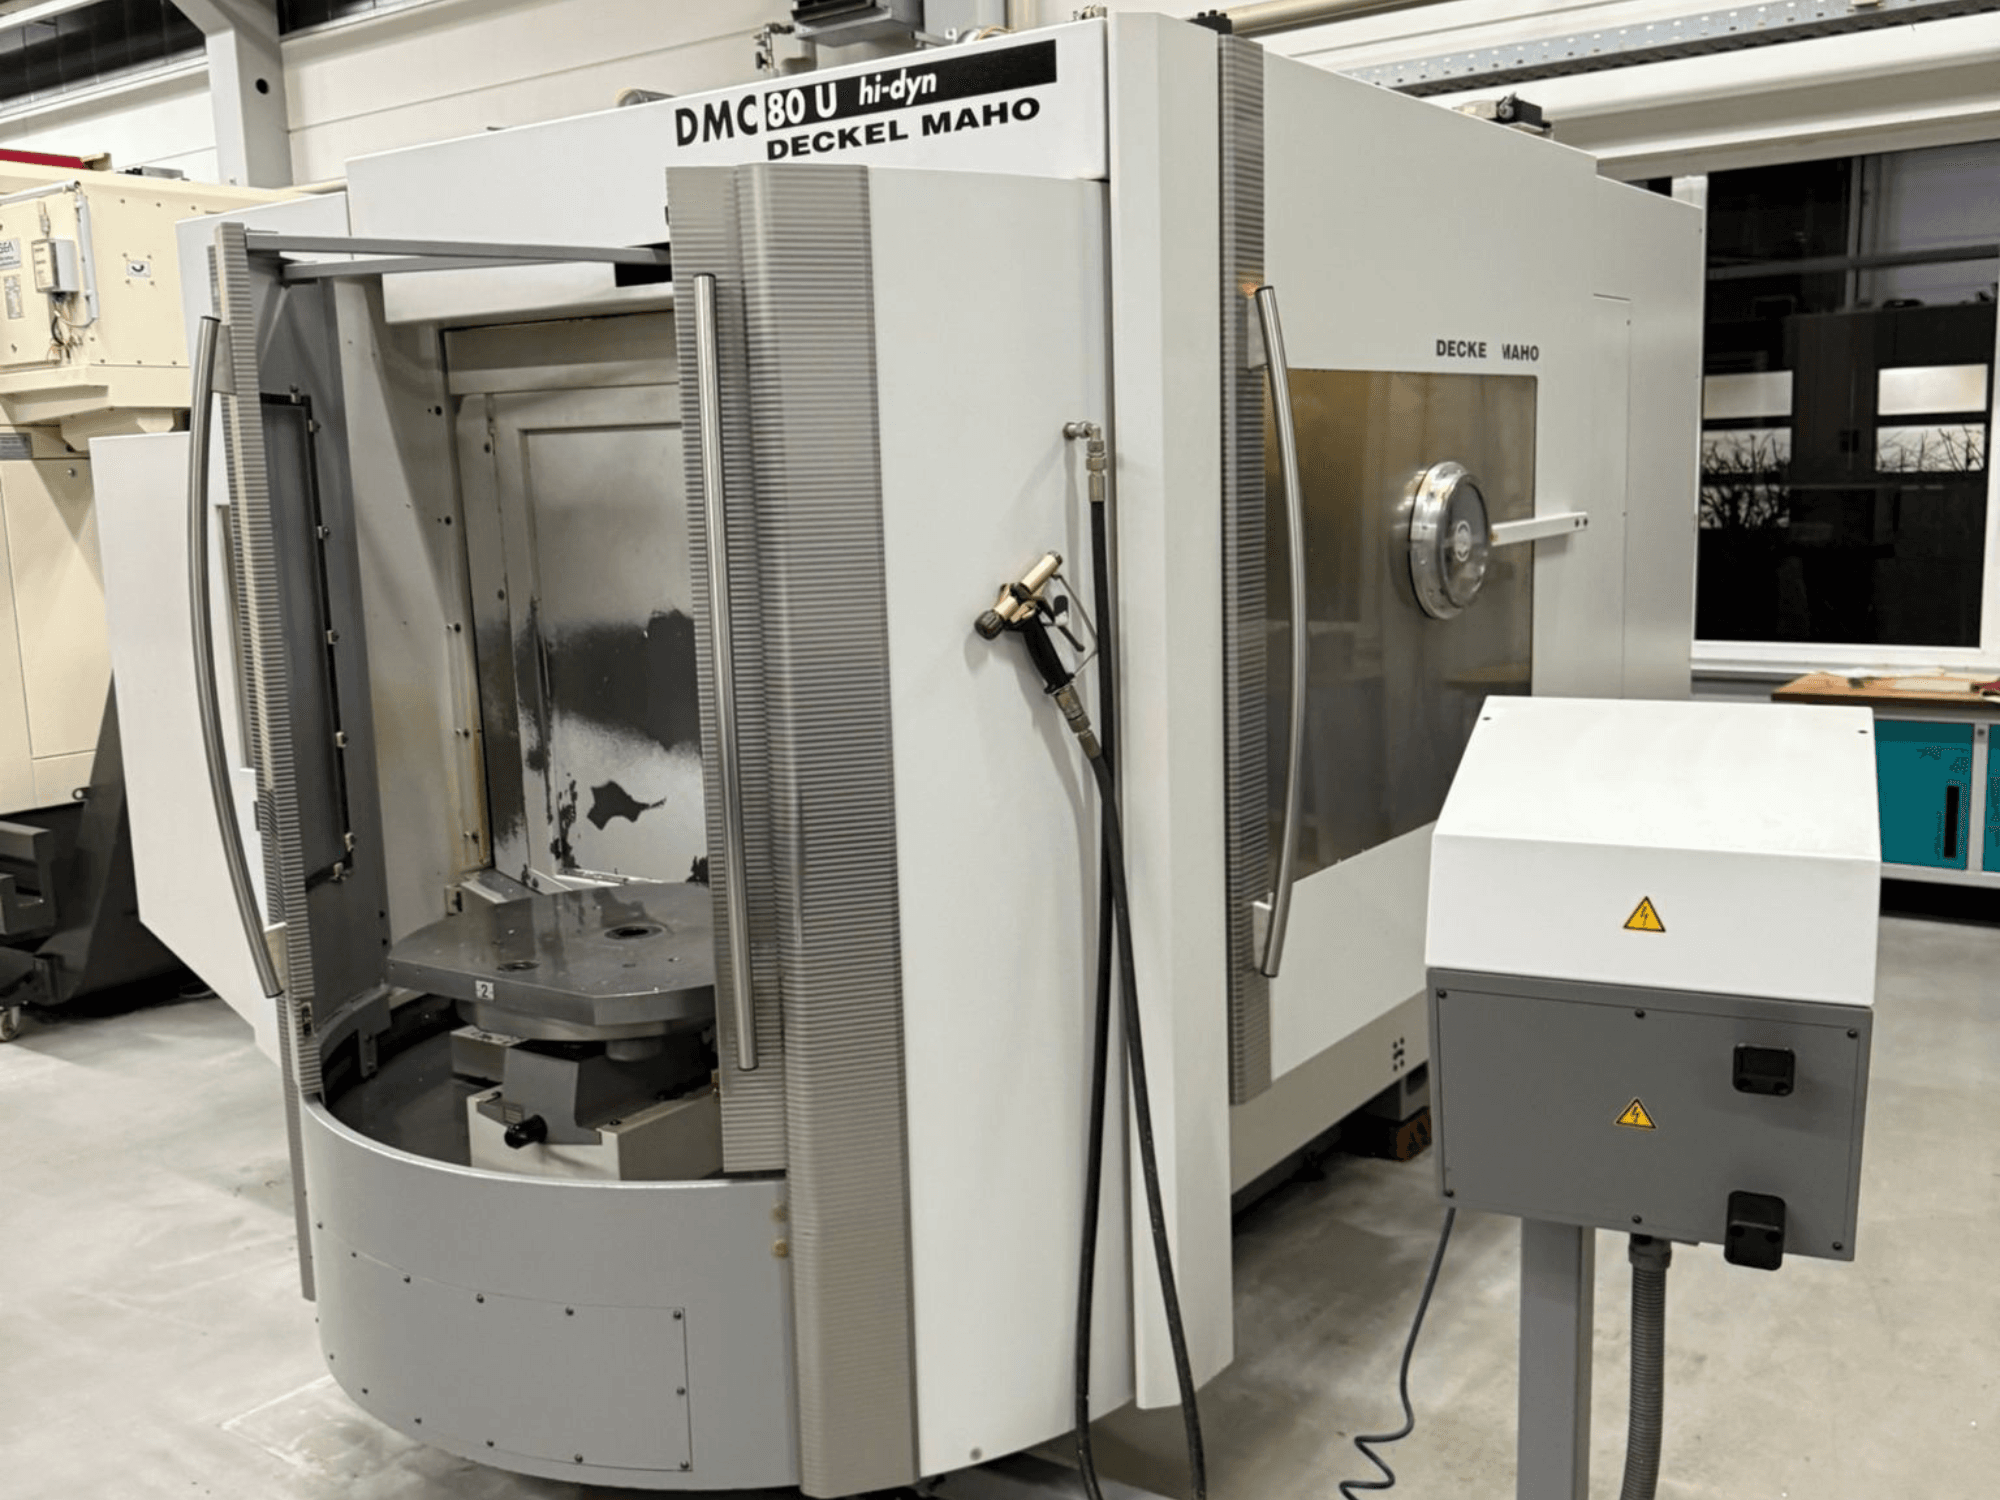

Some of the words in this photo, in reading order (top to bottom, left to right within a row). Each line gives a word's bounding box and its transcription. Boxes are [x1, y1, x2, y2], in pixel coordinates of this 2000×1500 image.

[676, 95, 758, 147] DMC
[767, 88, 806, 128] 80
[814, 83, 838, 118] U
[859, 68, 937, 106] hi-dyn
[767, 119, 908, 160] DECKEL
[922, 97, 1041, 137] MAHO
